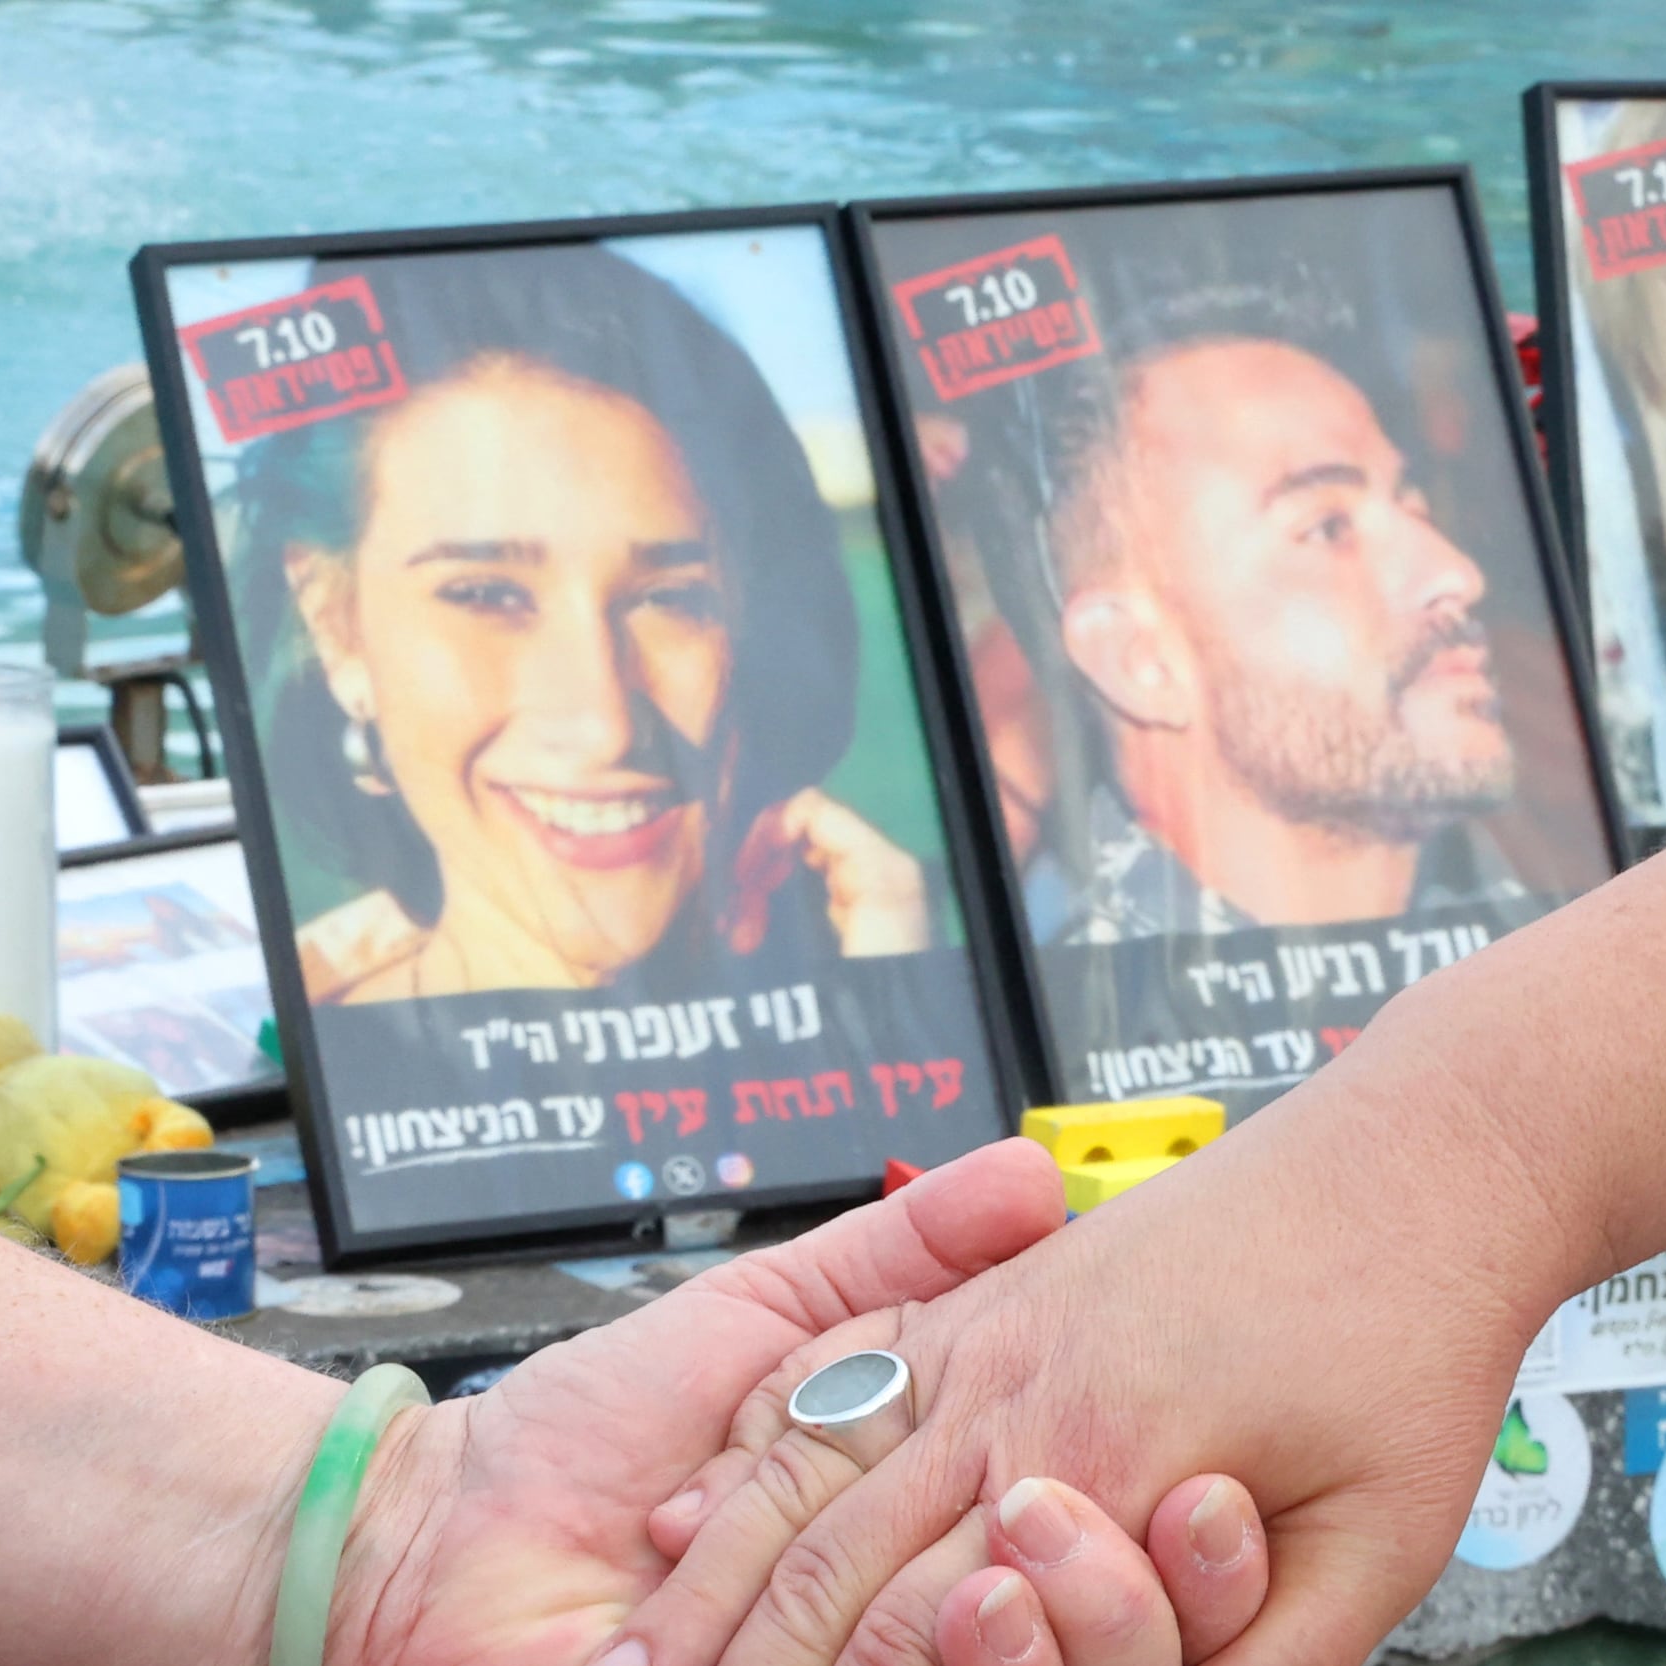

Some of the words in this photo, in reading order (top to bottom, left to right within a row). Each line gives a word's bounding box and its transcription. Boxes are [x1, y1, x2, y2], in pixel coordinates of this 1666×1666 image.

[945, 269, 1037, 326] 7.10
[235, 311, 336, 368] 7.10
[1277, 941, 1386, 1000] רביע
[565, 998, 737, 1063] זעפרני
[751, 984, 821, 1043] נוי
[1087, 1036, 1252, 1101] הניצחון!
[1253, 1029, 1314, 1072] עד
[615, 1088, 707, 1144] עין
[732, 1070, 853, 1124] תחת
[871, 1058, 965, 1118] עין
[346, 1099, 538, 1166] הניצחון!
[544, 1096, 605, 1139] עד
